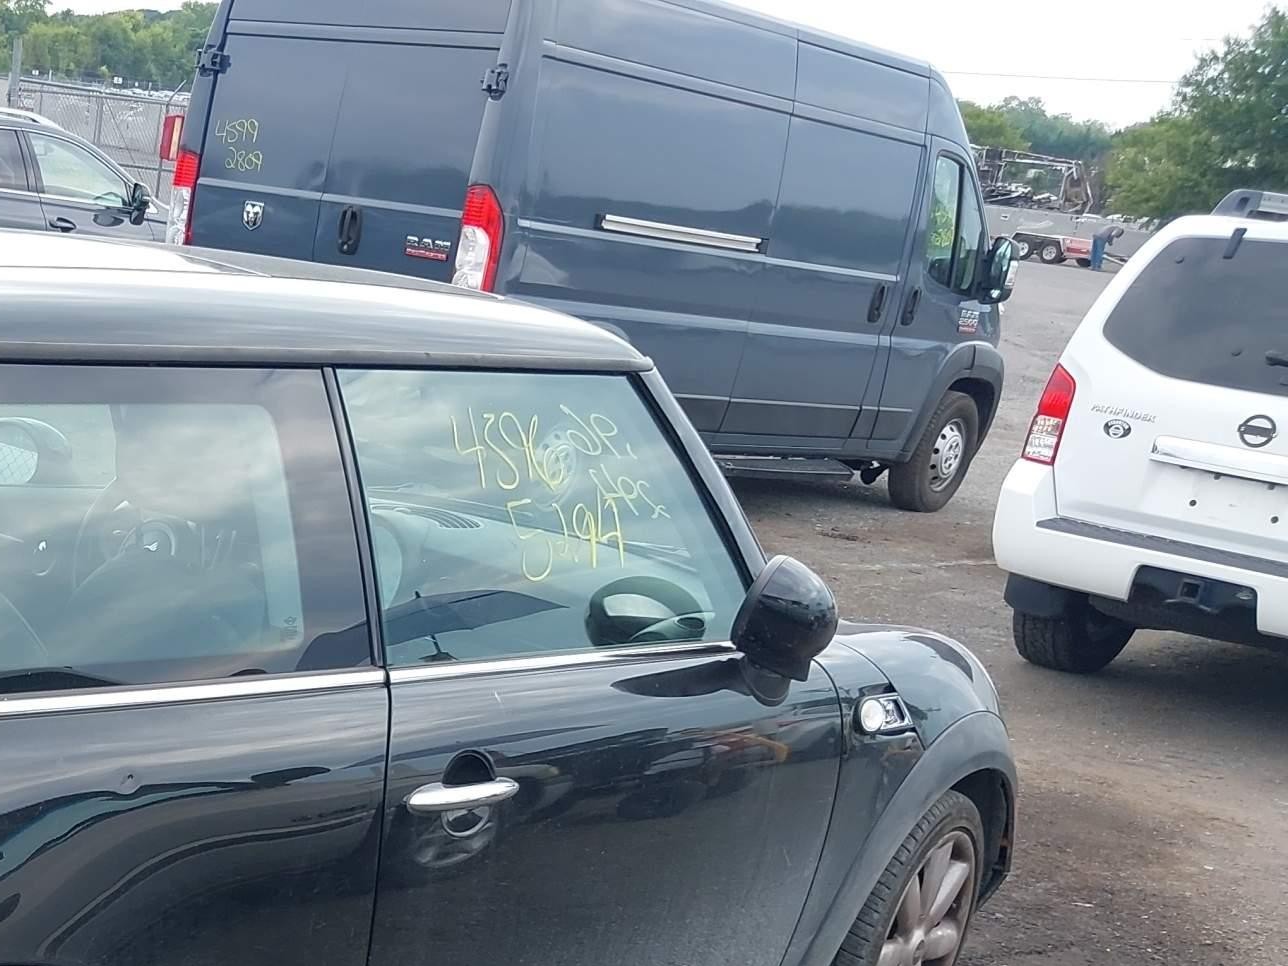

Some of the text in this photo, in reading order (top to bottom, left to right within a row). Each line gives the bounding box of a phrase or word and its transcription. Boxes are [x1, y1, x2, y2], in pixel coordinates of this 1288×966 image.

[215, 118, 259, 144] 4599
[224, 146, 262, 172] 2809
[406, 235, 452, 251] RAM
[1090, 404, 1157, 424] PATHFINDER
